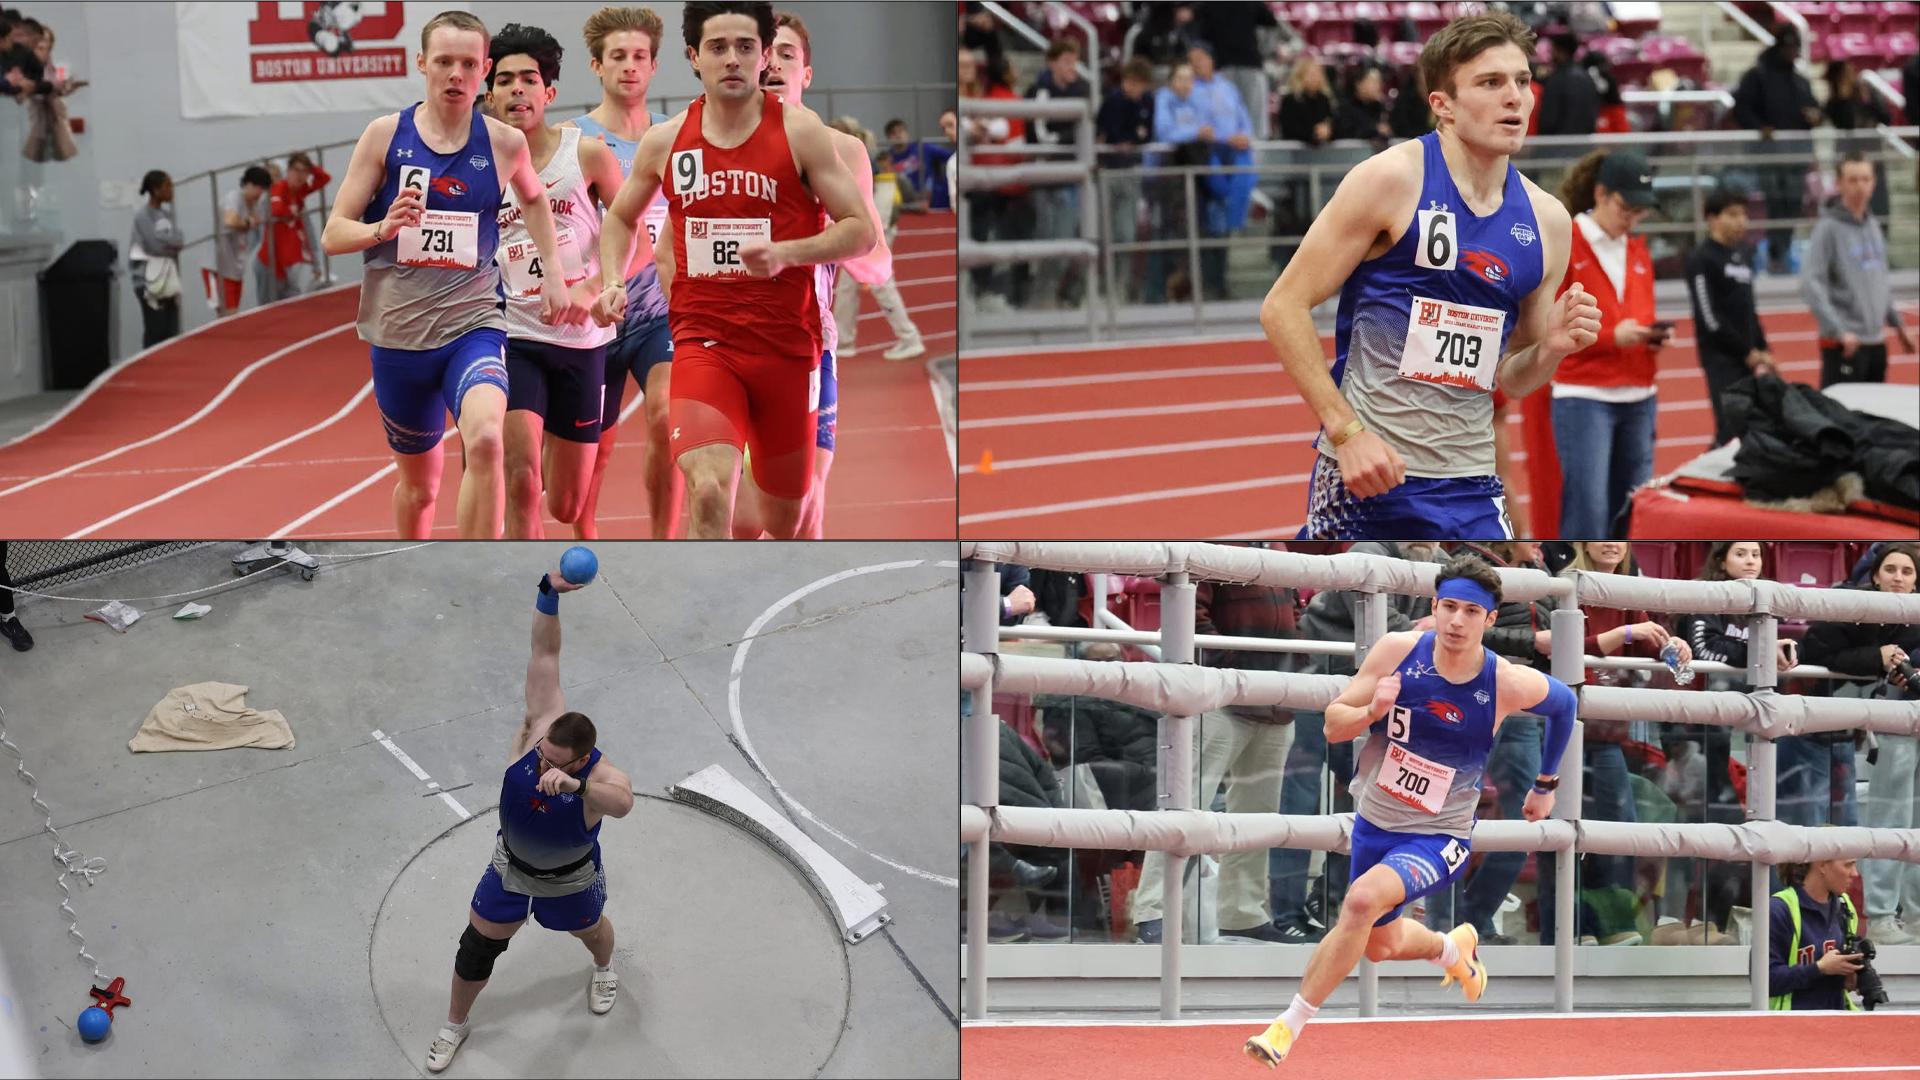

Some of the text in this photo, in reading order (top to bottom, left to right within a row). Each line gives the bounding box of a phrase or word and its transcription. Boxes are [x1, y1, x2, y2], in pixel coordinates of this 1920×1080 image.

[256, 55, 403, 78] BOSTON UNIVERSITY
[678, 152, 697, 192] 9
[496, 207, 523, 229] STON
[550, 198, 575, 216] OOK
[691, 221, 709, 236] BU
[421, 229, 454, 253] 731
[507, 244, 524, 260] BU
[1427, 214, 1451, 267] 6
[713, 241, 740, 265] 82
[528, 256, 544, 278] 4
[1419, 301, 1443, 323] BU
[1446, 308, 1500, 324] BOSTON UNIVERSITY
[1435, 329, 1482, 369] 703
[1391, 707, 1406, 739] 5
[1391, 746, 1407, 762] BU
[1396, 766, 1431, 796] 700
[1446, 843, 1467, 867] 5
